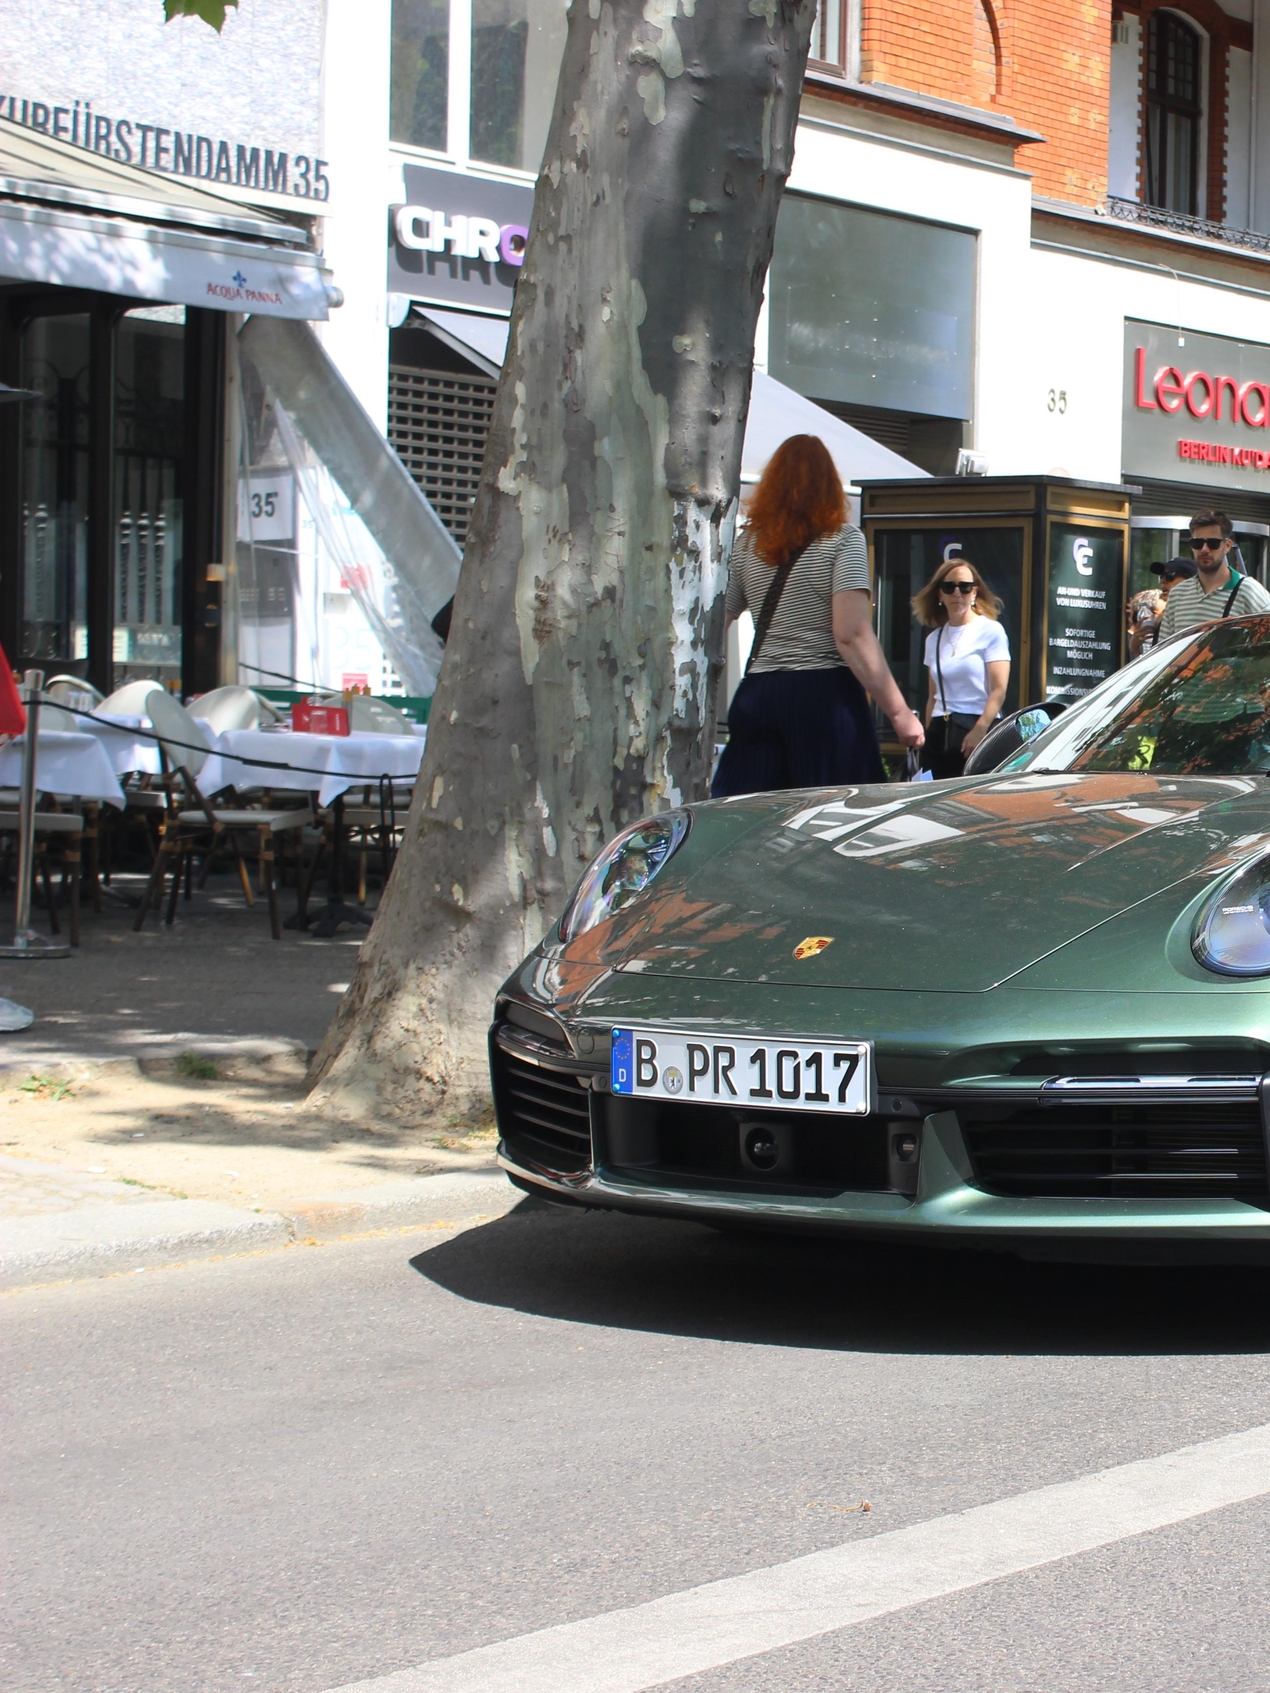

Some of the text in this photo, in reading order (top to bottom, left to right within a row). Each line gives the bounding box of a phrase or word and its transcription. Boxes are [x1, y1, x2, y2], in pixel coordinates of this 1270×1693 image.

[294, 155, 330, 203] 35
[207, 282, 283, 304] ACQUA PANNA
[1047, 388, 1067, 414] 35
[1178, 438, 1231, 464] BERLIN
[251, 492, 277, 518] 35
[1080, 588, 1106, 599] VERKAUF
[1056, 597, 1069, 607] VON
[1065, 628, 1096, 638] SOFORTIGE
[1049, 638, 1111, 651] BARGELDAUSZAHLUNG
[1067, 649, 1093, 660] MÖGLICH
[1053, 666, 1105, 678] INZAHLUNGNAHME
[618, 1068, 627, 1082] D
[636, 1039, 862, 1103] B PR 1017
